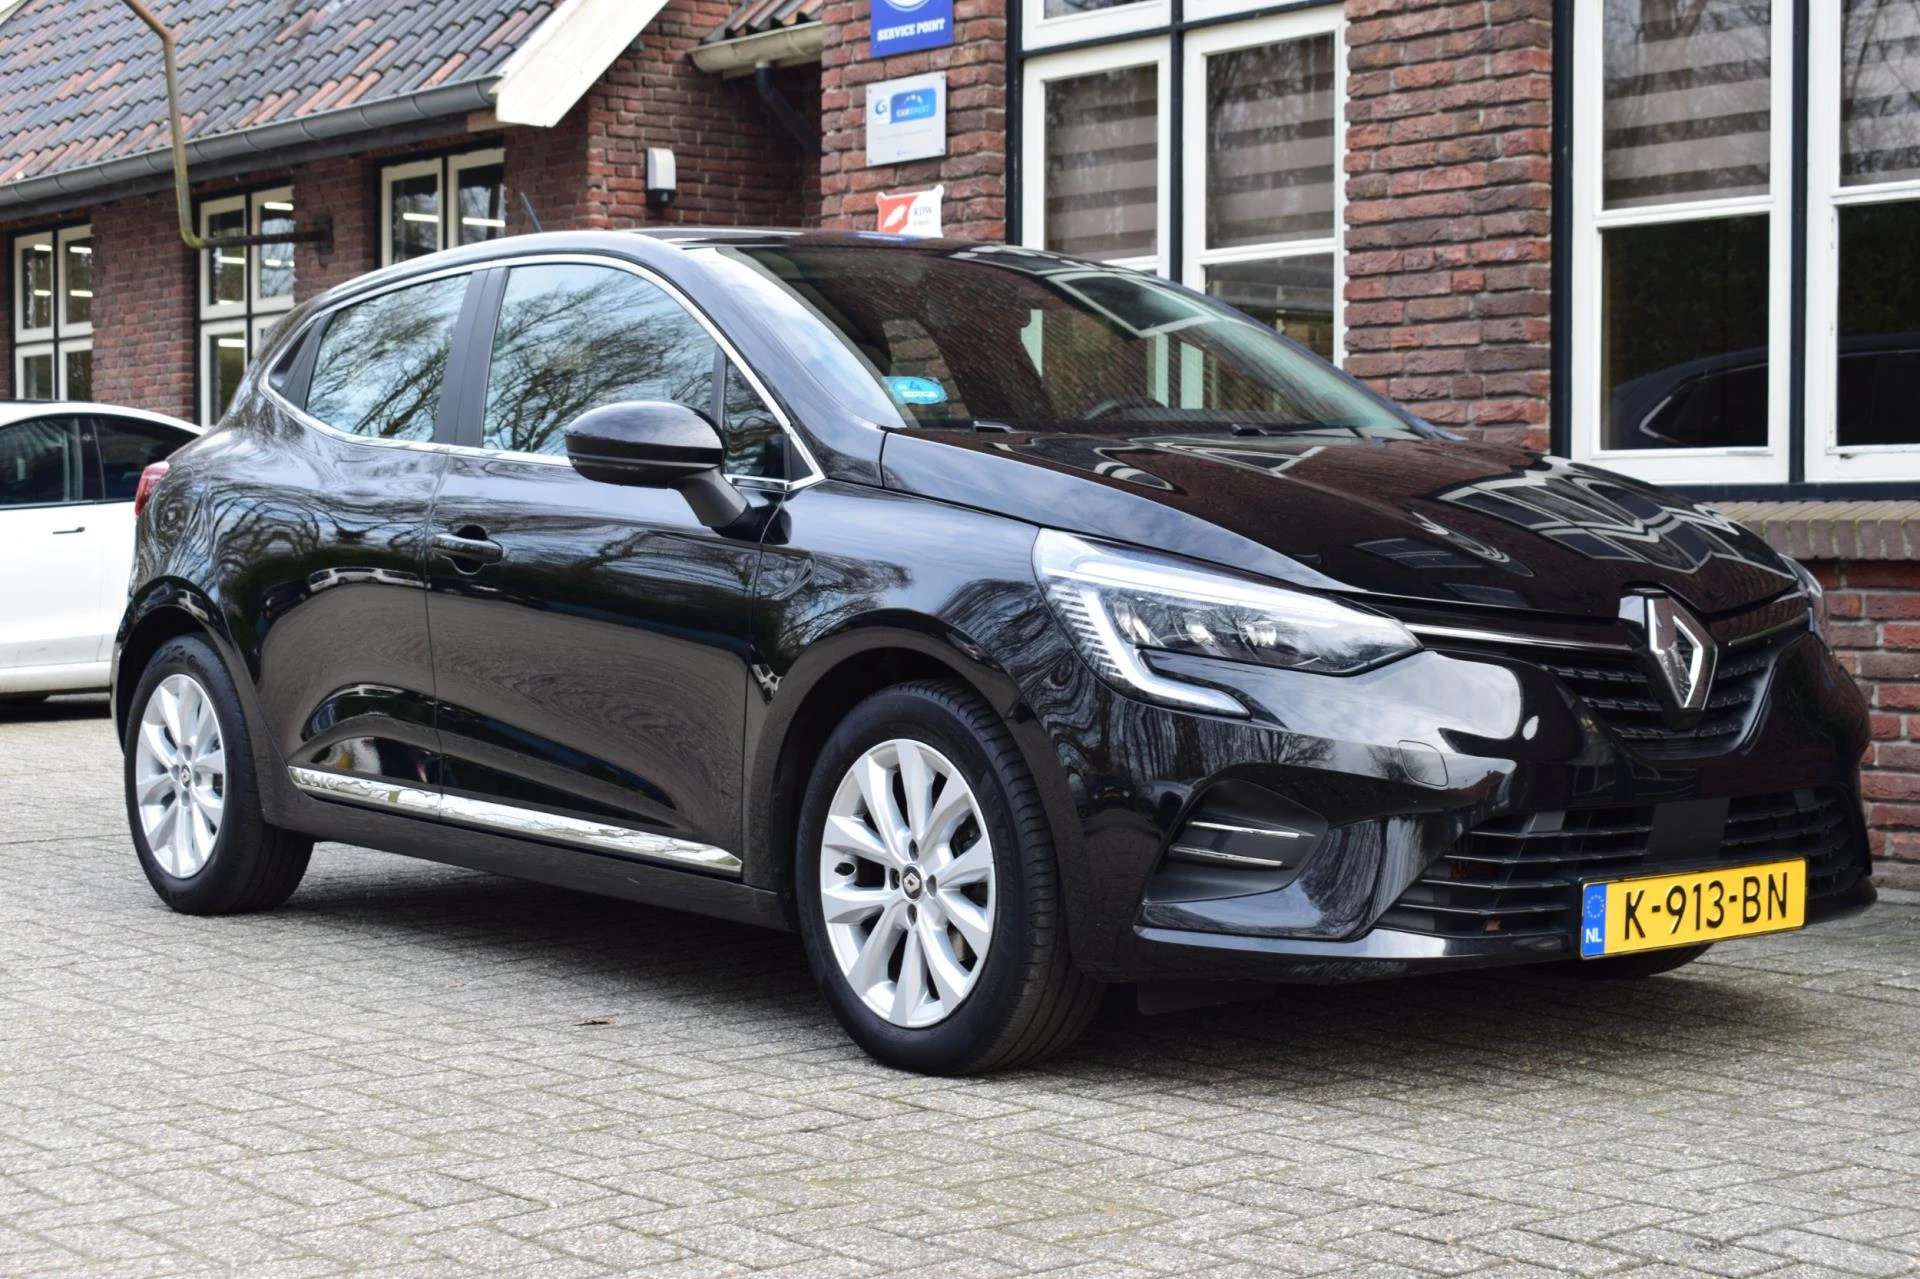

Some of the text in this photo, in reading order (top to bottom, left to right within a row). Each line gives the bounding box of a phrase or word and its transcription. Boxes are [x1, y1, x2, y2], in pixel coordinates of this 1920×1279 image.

[877, 18, 946, 42] SERVICE POINT
[1624, 872, 1788, 940] K-913-BN
[1585, 928, 1602, 943] NL
